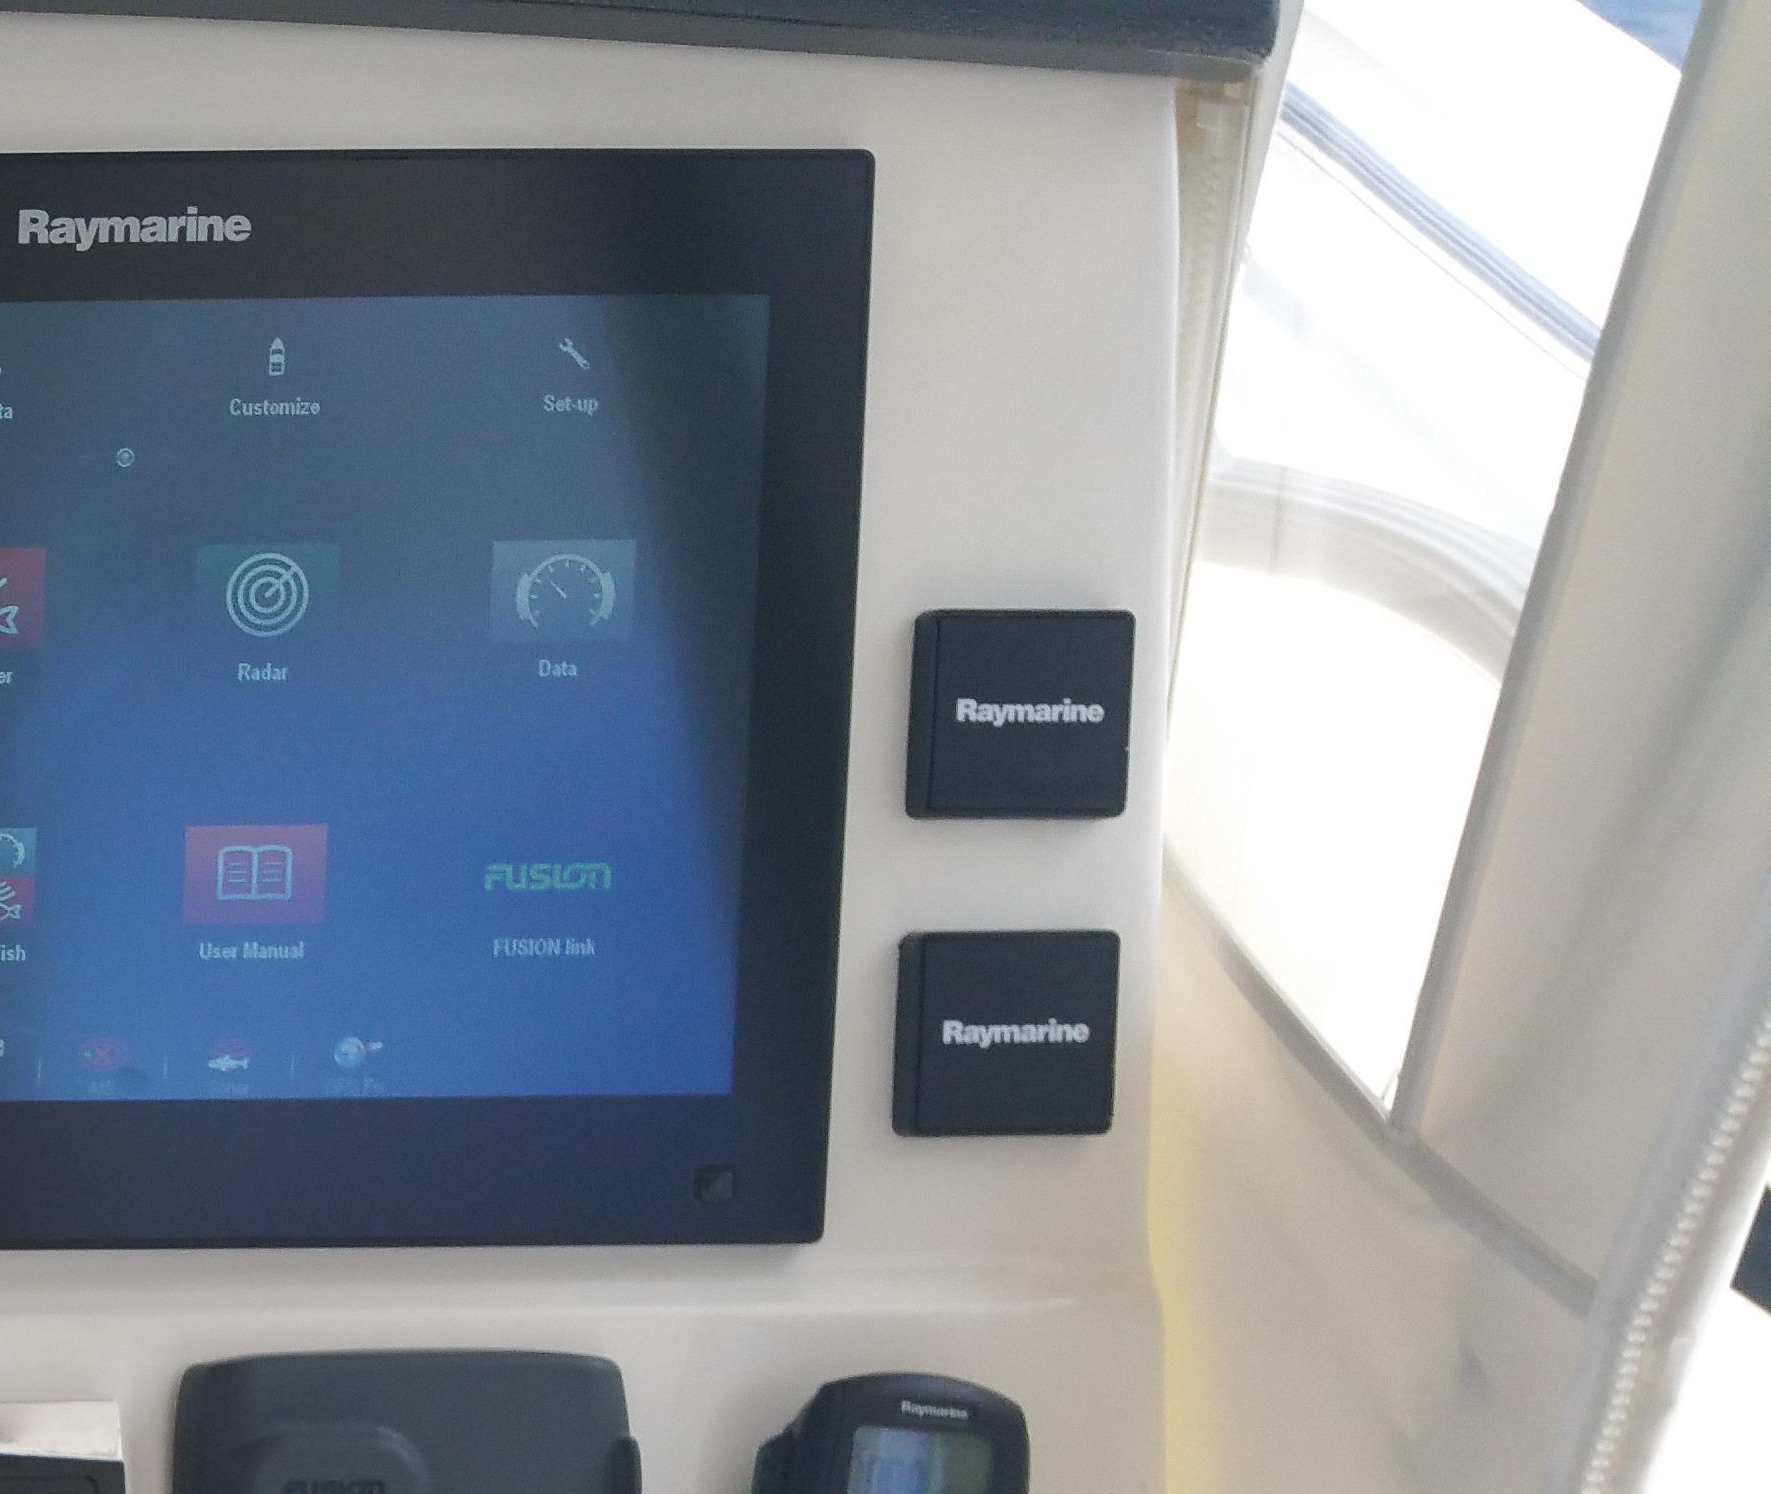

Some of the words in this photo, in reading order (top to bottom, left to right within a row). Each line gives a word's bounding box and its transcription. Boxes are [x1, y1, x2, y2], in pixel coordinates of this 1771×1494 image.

[17, 206, 251, 251] Raymarine
[229, 397, 320, 416] Customize
[544, 394, 598, 416] Set-up
[238, 663, 289, 682] Radar
[538, 660, 578, 678] Data
[956, 698, 1105, 726] Raymarine
[484, 863, 611, 890] FUSION
[199, 942, 238, 960] User
[243, 941, 304, 960] Manual
[493, 939, 560, 957] FUSION
[565, 938, 596, 956] link
[942, 1018, 1090, 1048] Raymarine
